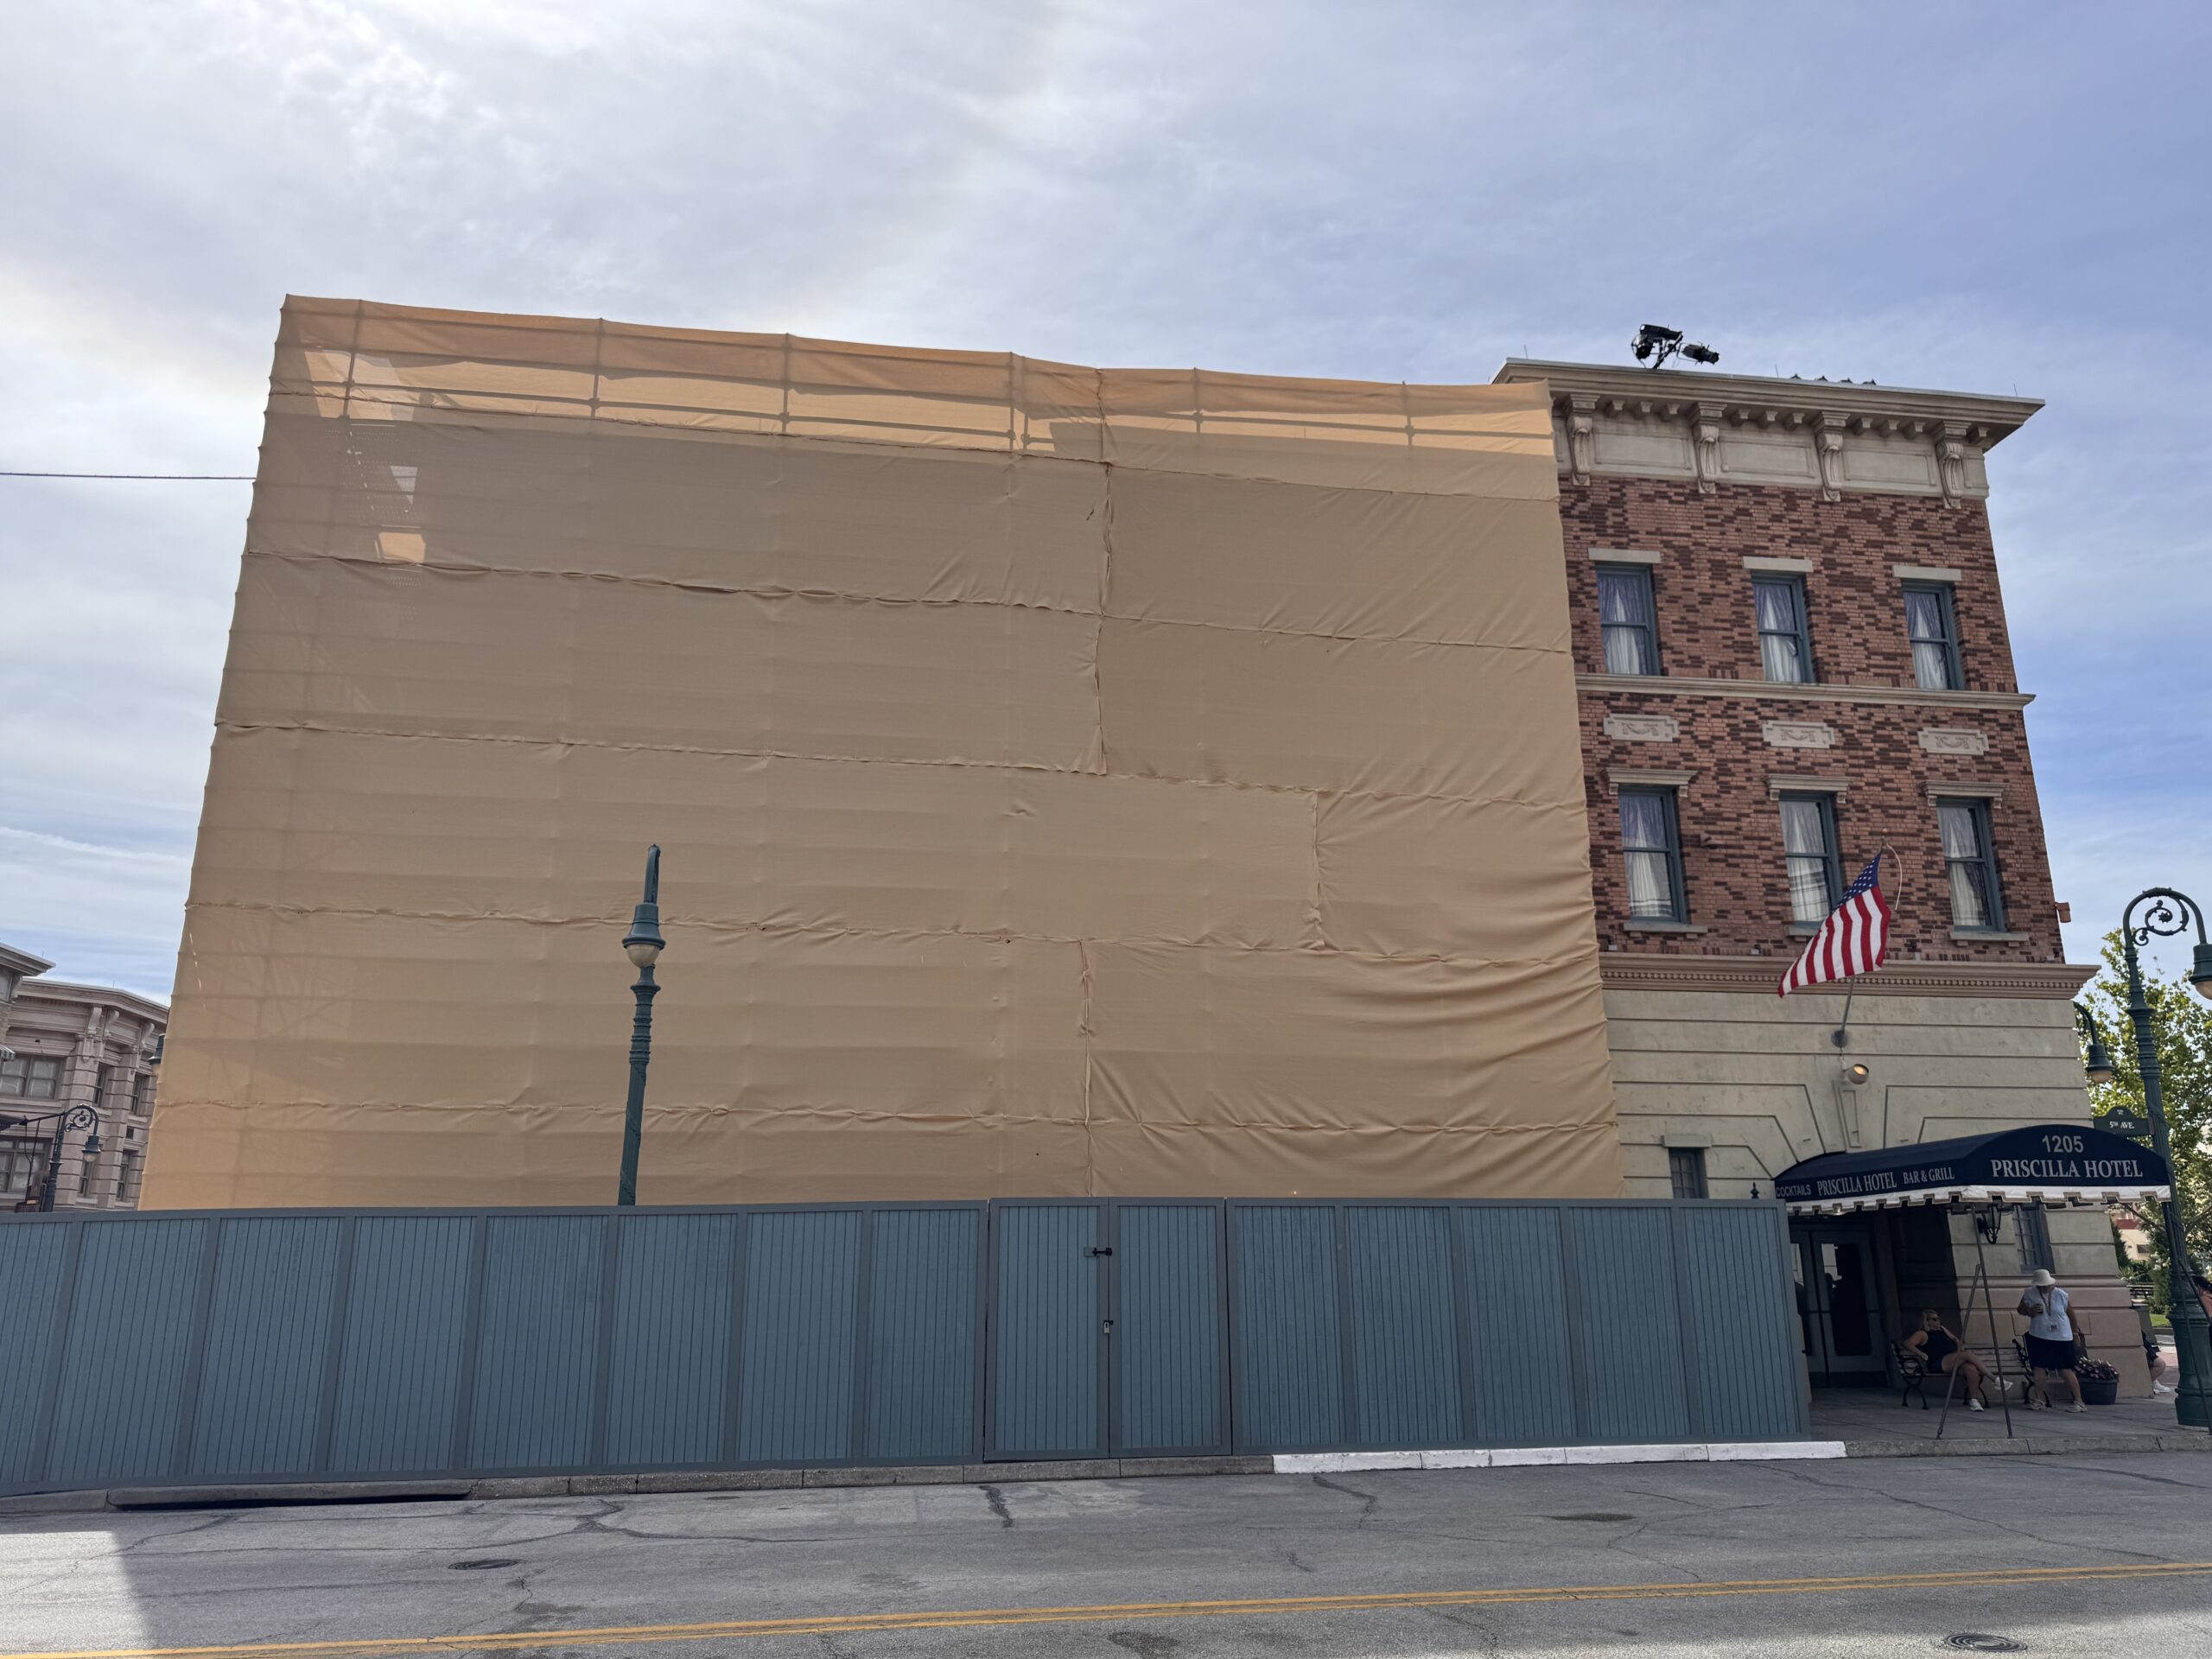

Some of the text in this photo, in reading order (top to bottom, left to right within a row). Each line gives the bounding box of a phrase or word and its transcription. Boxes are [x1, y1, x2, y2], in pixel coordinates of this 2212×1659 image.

[2042, 1135, 2084, 1154] 1205
[1990, 1160, 2144, 1179] PRISCILLA HOTEL
[1776, 1166, 1955, 1198] COCKTAILS PRISCILLA HOTEL BAR & GRILL
